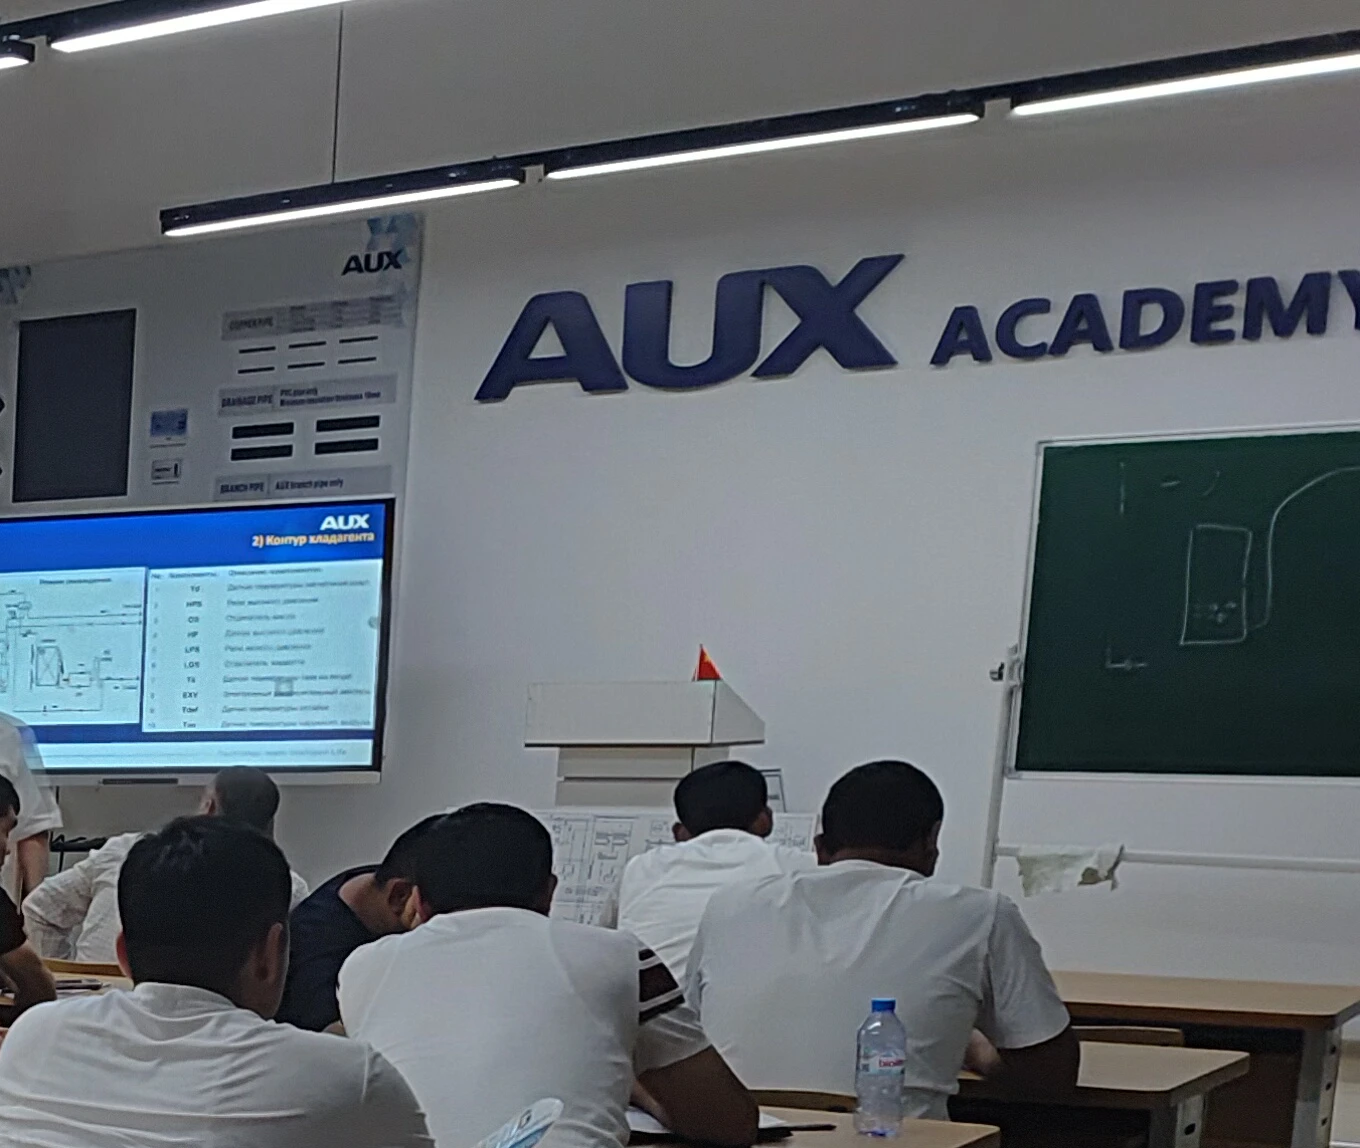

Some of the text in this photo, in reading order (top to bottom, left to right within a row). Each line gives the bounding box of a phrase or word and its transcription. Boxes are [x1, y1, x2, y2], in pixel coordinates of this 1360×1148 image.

[342, 249, 403, 276] AUX
[474, 253, 905, 403] AUX
[320, 514, 370, 530] AUX
[252, 532, 375, 548] 2) Контур хладагента
